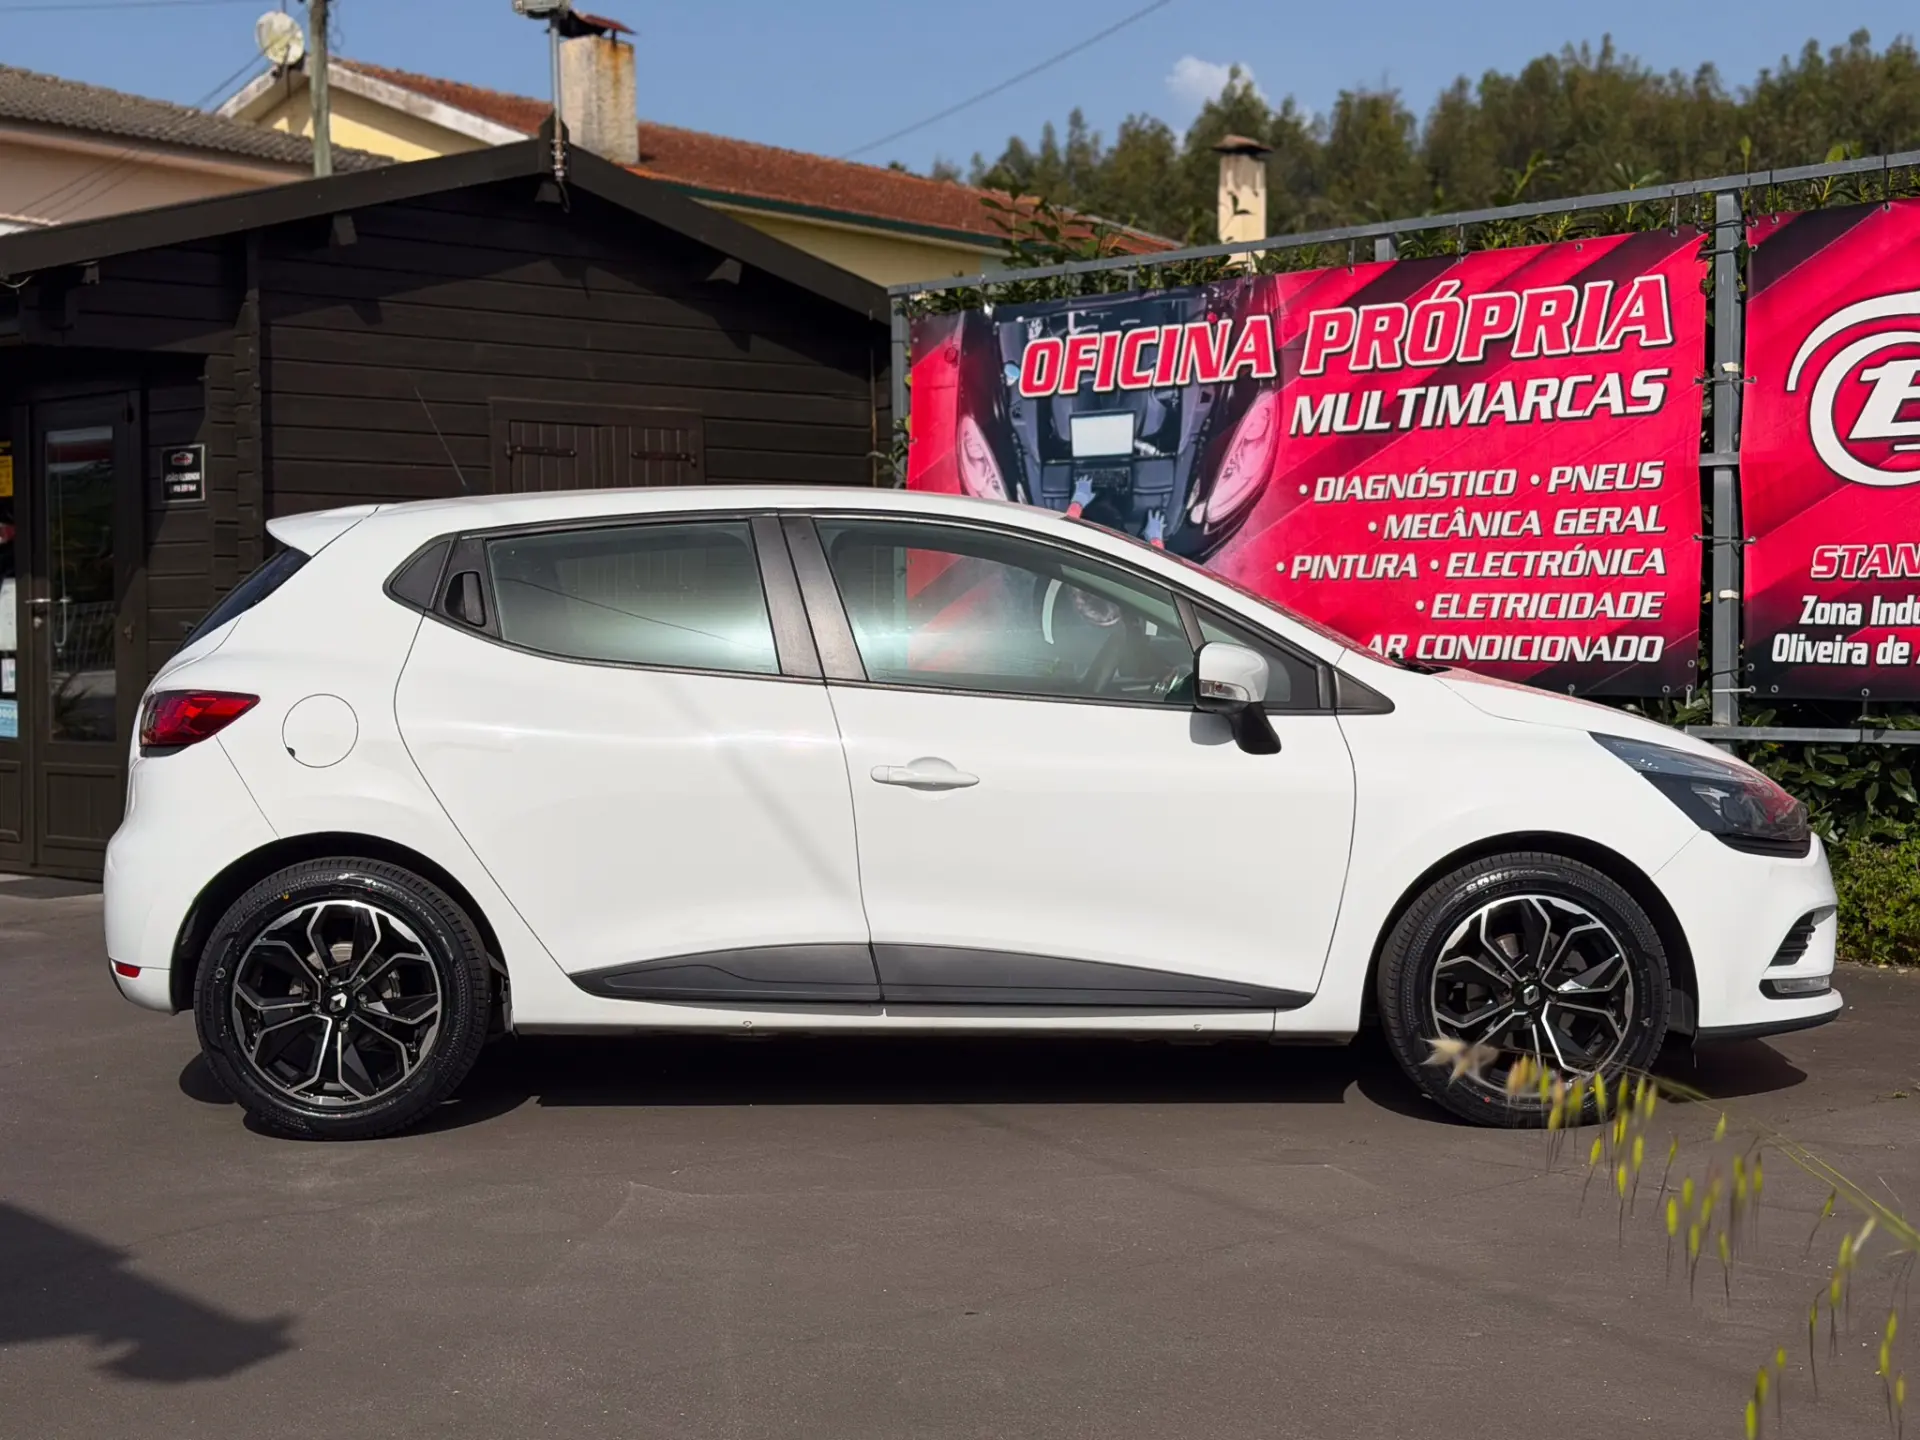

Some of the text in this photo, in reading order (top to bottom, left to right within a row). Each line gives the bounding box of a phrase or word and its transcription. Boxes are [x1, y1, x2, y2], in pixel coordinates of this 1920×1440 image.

[1018, 274, 1673, 397] OFICINA PRÓPRIA
[1289, 368, 1669, 436] MULTIMARCAS
[1313, 460, 1664, 502] DIAGNÓSTICO PNEUS
[1383, 505, 1666, 540] MECÂNICA GERAL
[1290, 543, 1666, 580] PINTURA ELECTRÓNICA
[1431, 591, 1665, 620] ELETRICIDADE
[1798, 594, 1863, 626] Zona
[1367, 634, 1664, 663] AR CONDICIONADO
[1771, 633, 1869, 665] Oliveira
[1876, 634, 1910, 665] de
